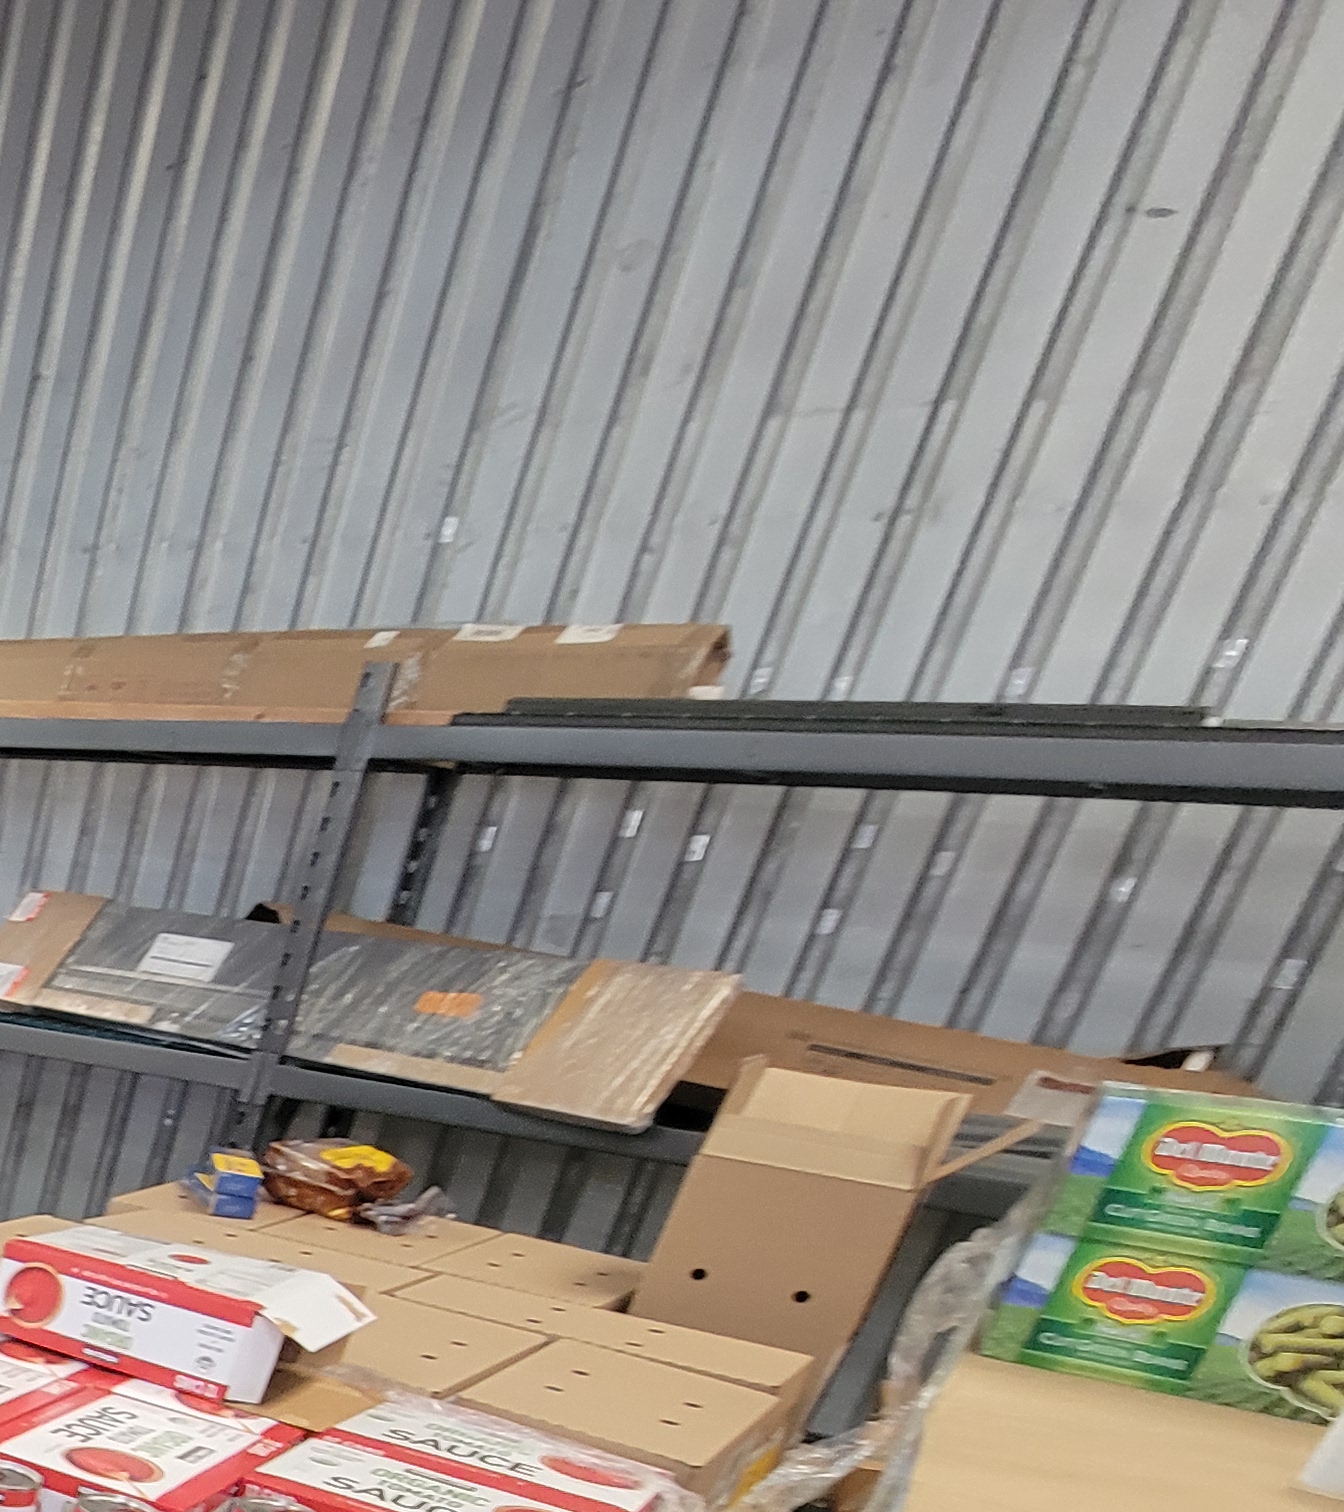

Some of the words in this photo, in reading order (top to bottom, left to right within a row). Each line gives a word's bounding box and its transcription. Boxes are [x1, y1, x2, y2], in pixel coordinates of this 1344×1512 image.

[80, 1286, 156, 1322] SAUCE
[49, 1405, 139, 1443] SAUCE
[382, 1429, 544, 1477] SAUCE
